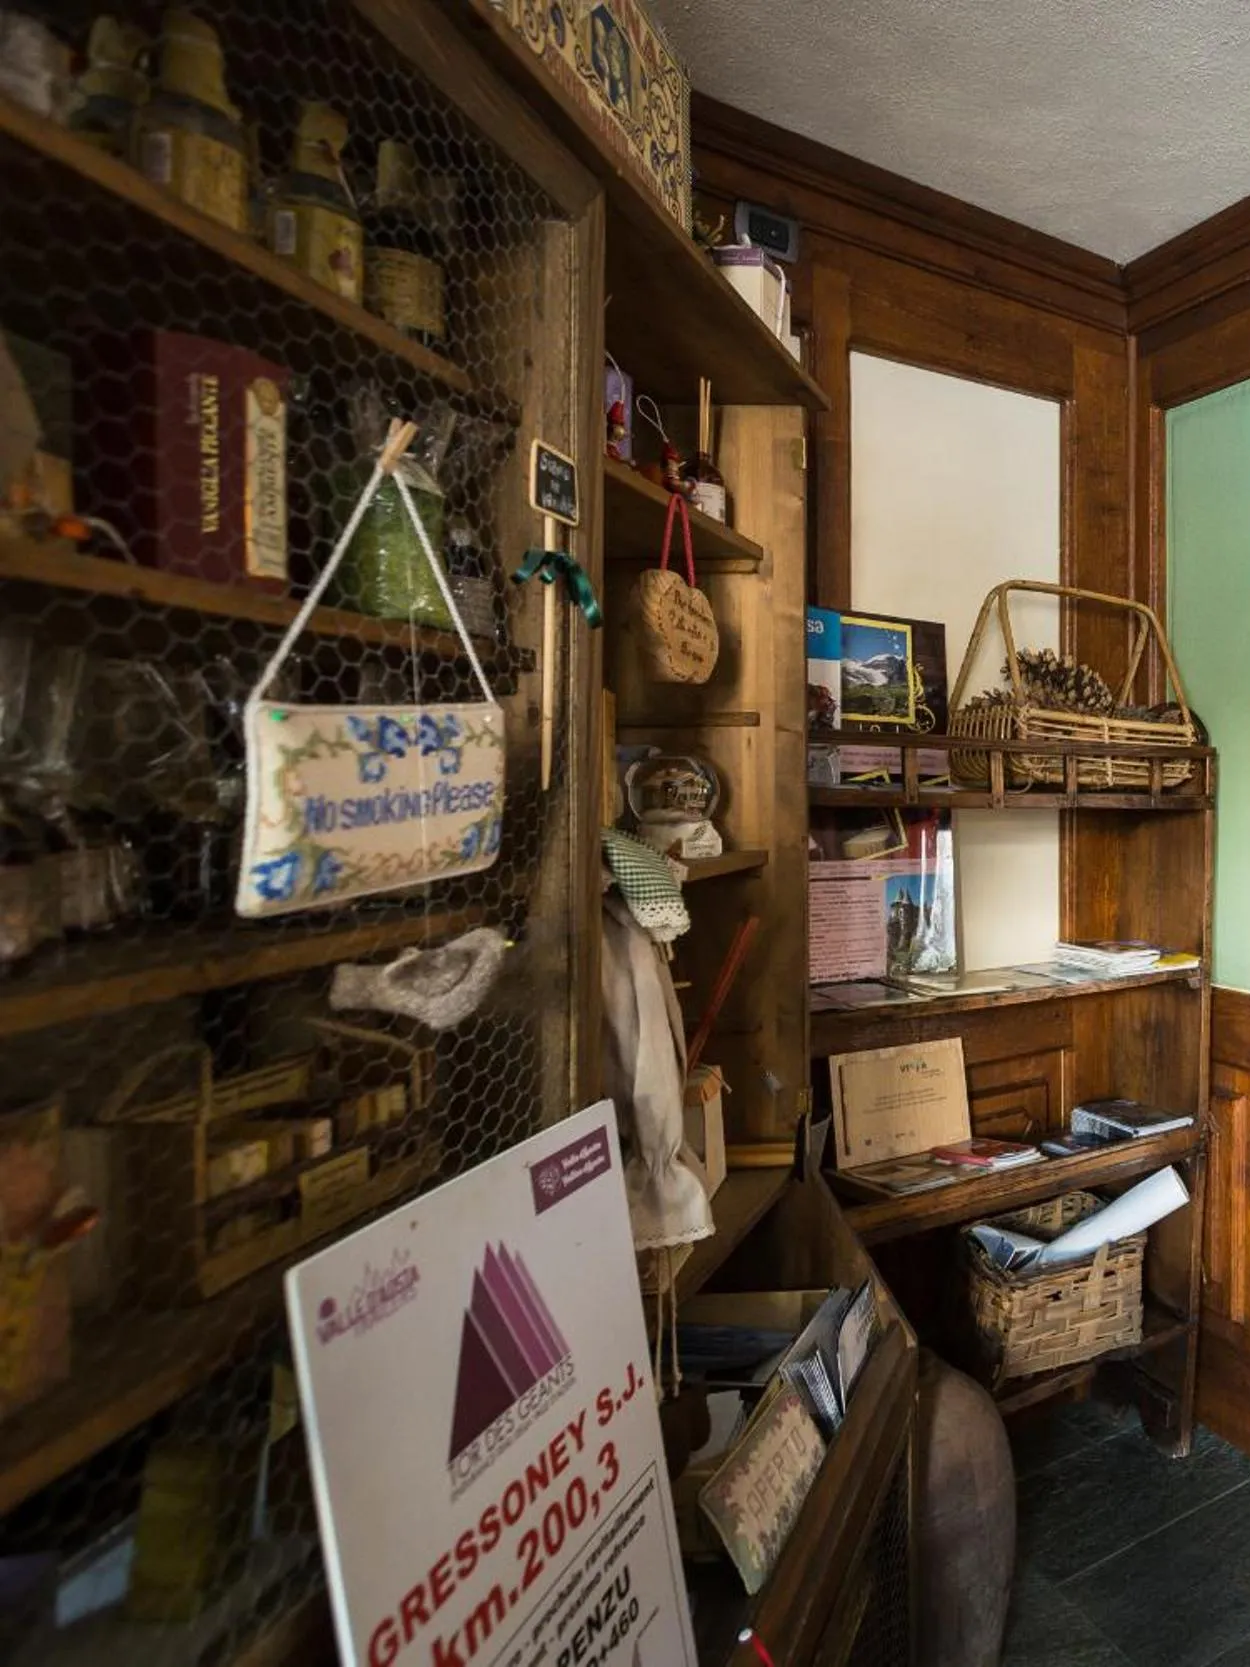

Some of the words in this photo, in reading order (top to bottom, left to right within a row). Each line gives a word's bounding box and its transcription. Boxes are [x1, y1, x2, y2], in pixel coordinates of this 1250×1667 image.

[367, 1408, 587, 1667] GRESSONEY
[595, 1361, 645, 1427] S.J.
[484, 1408, 515, 1453] DES
